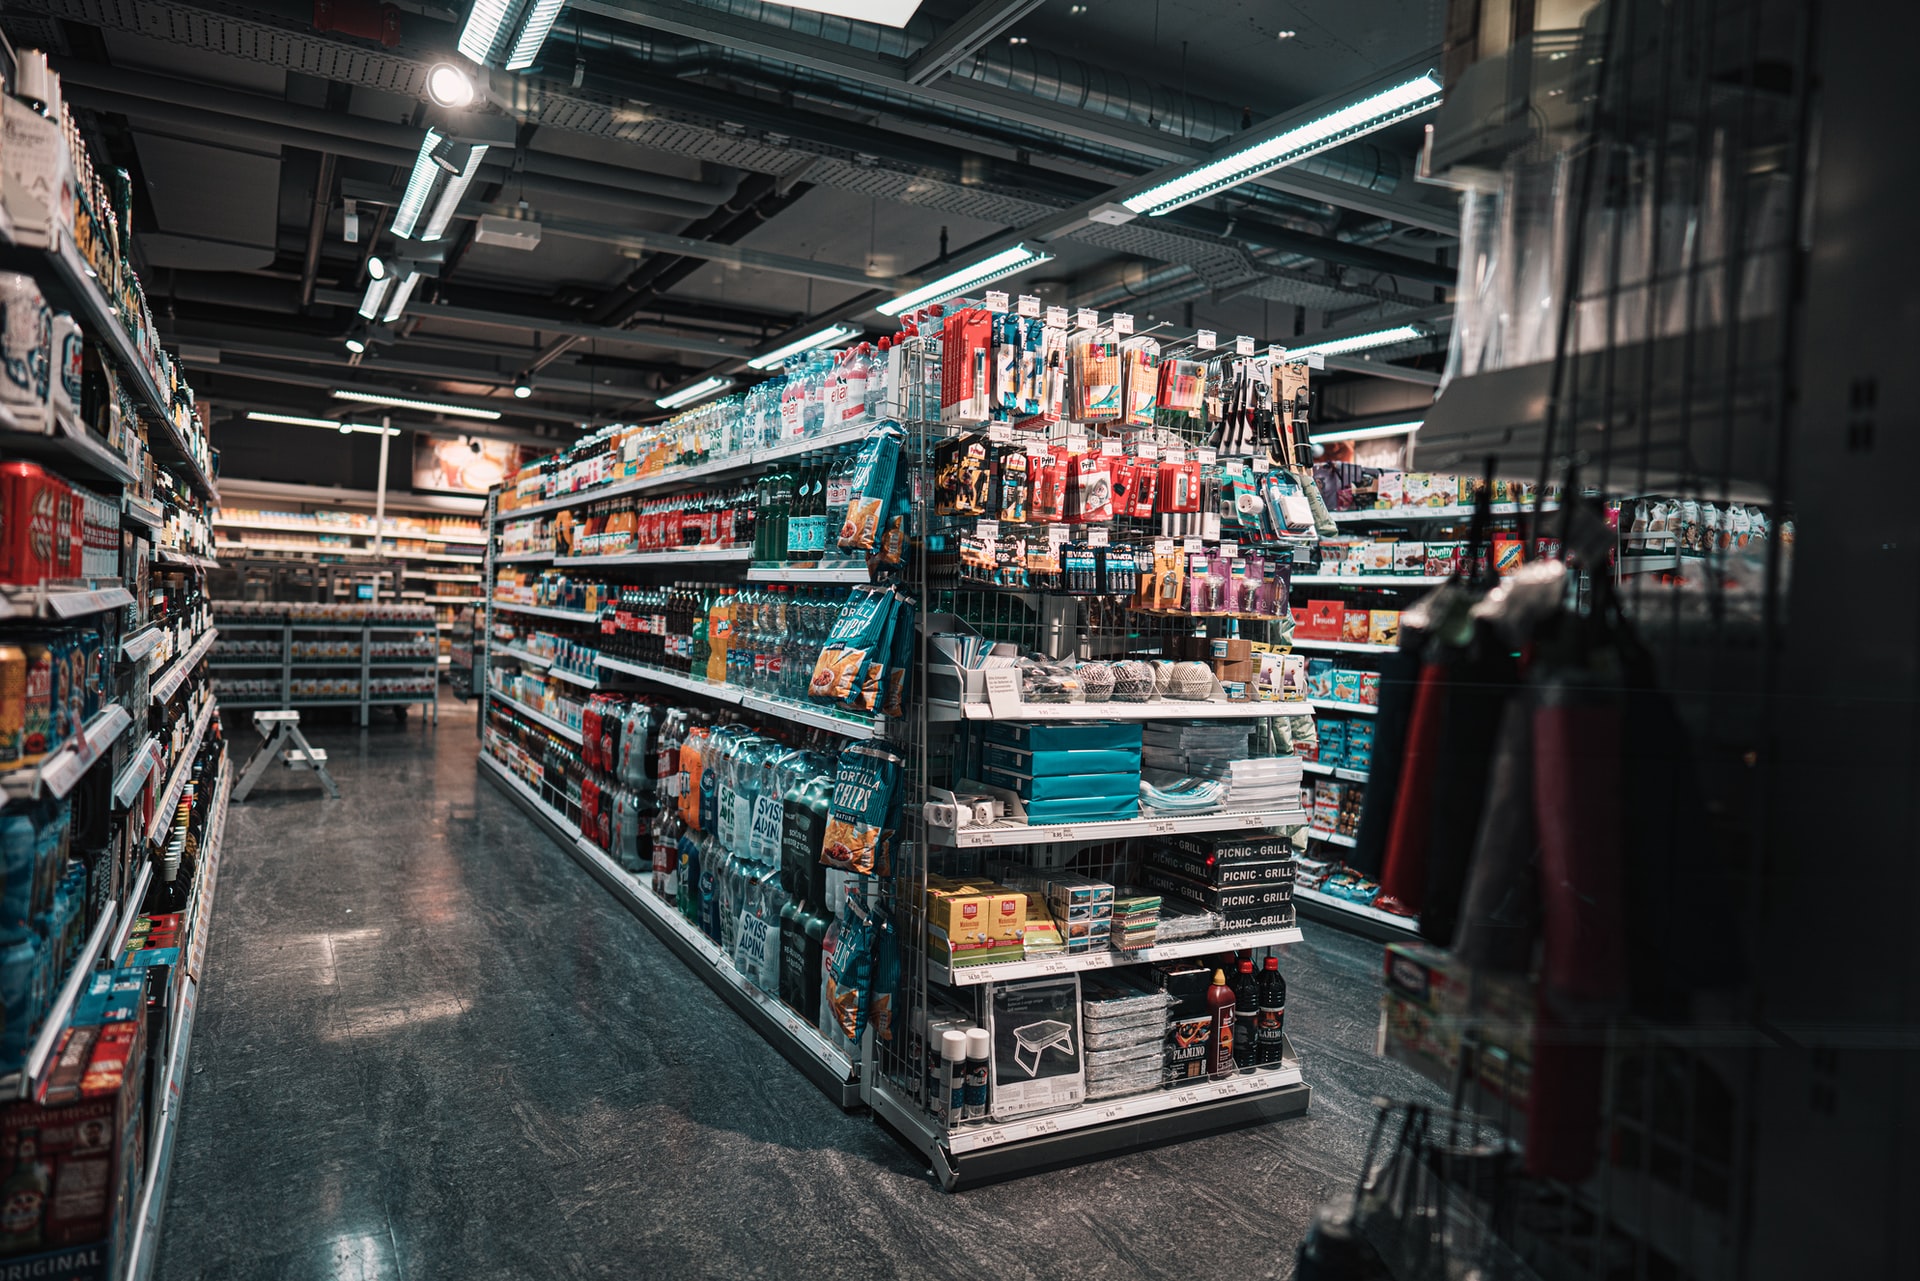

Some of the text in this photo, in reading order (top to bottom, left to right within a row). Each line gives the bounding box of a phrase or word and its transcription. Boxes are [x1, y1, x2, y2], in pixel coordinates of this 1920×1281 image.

[1041, 456, 1055, 465] Pritt
[1082, 461, 1095, 471] Pritt
[1428, 545, 1454, 559] Country
[1335, 674, 1358, 685] Country
[837, 771, 880, 791] TORTILLA
[834, 783, 872, 812] CHIPS
[1218, 847, 1252, 859] PICNIC
[1260, 844, 1289, 856] GRILL
[1223, 870, 1257, 882] PICNIC
[1265, 867, 1292, 878] GRILL
[1180, 885, 1205, 903] GRILL
[1222, 894, 1255, 907] PICNIC
[1263, 891, 1291, 903] GRILL
[744, 913, 768, 942] SWISS
[1260, 913, 1288, 926] GRILL
[740, 933, 765, 962] ALPINA
[1173, 1045, 1206, 1061] FLAMINO
[0, 1250, 99, 1281] RIGINAL
